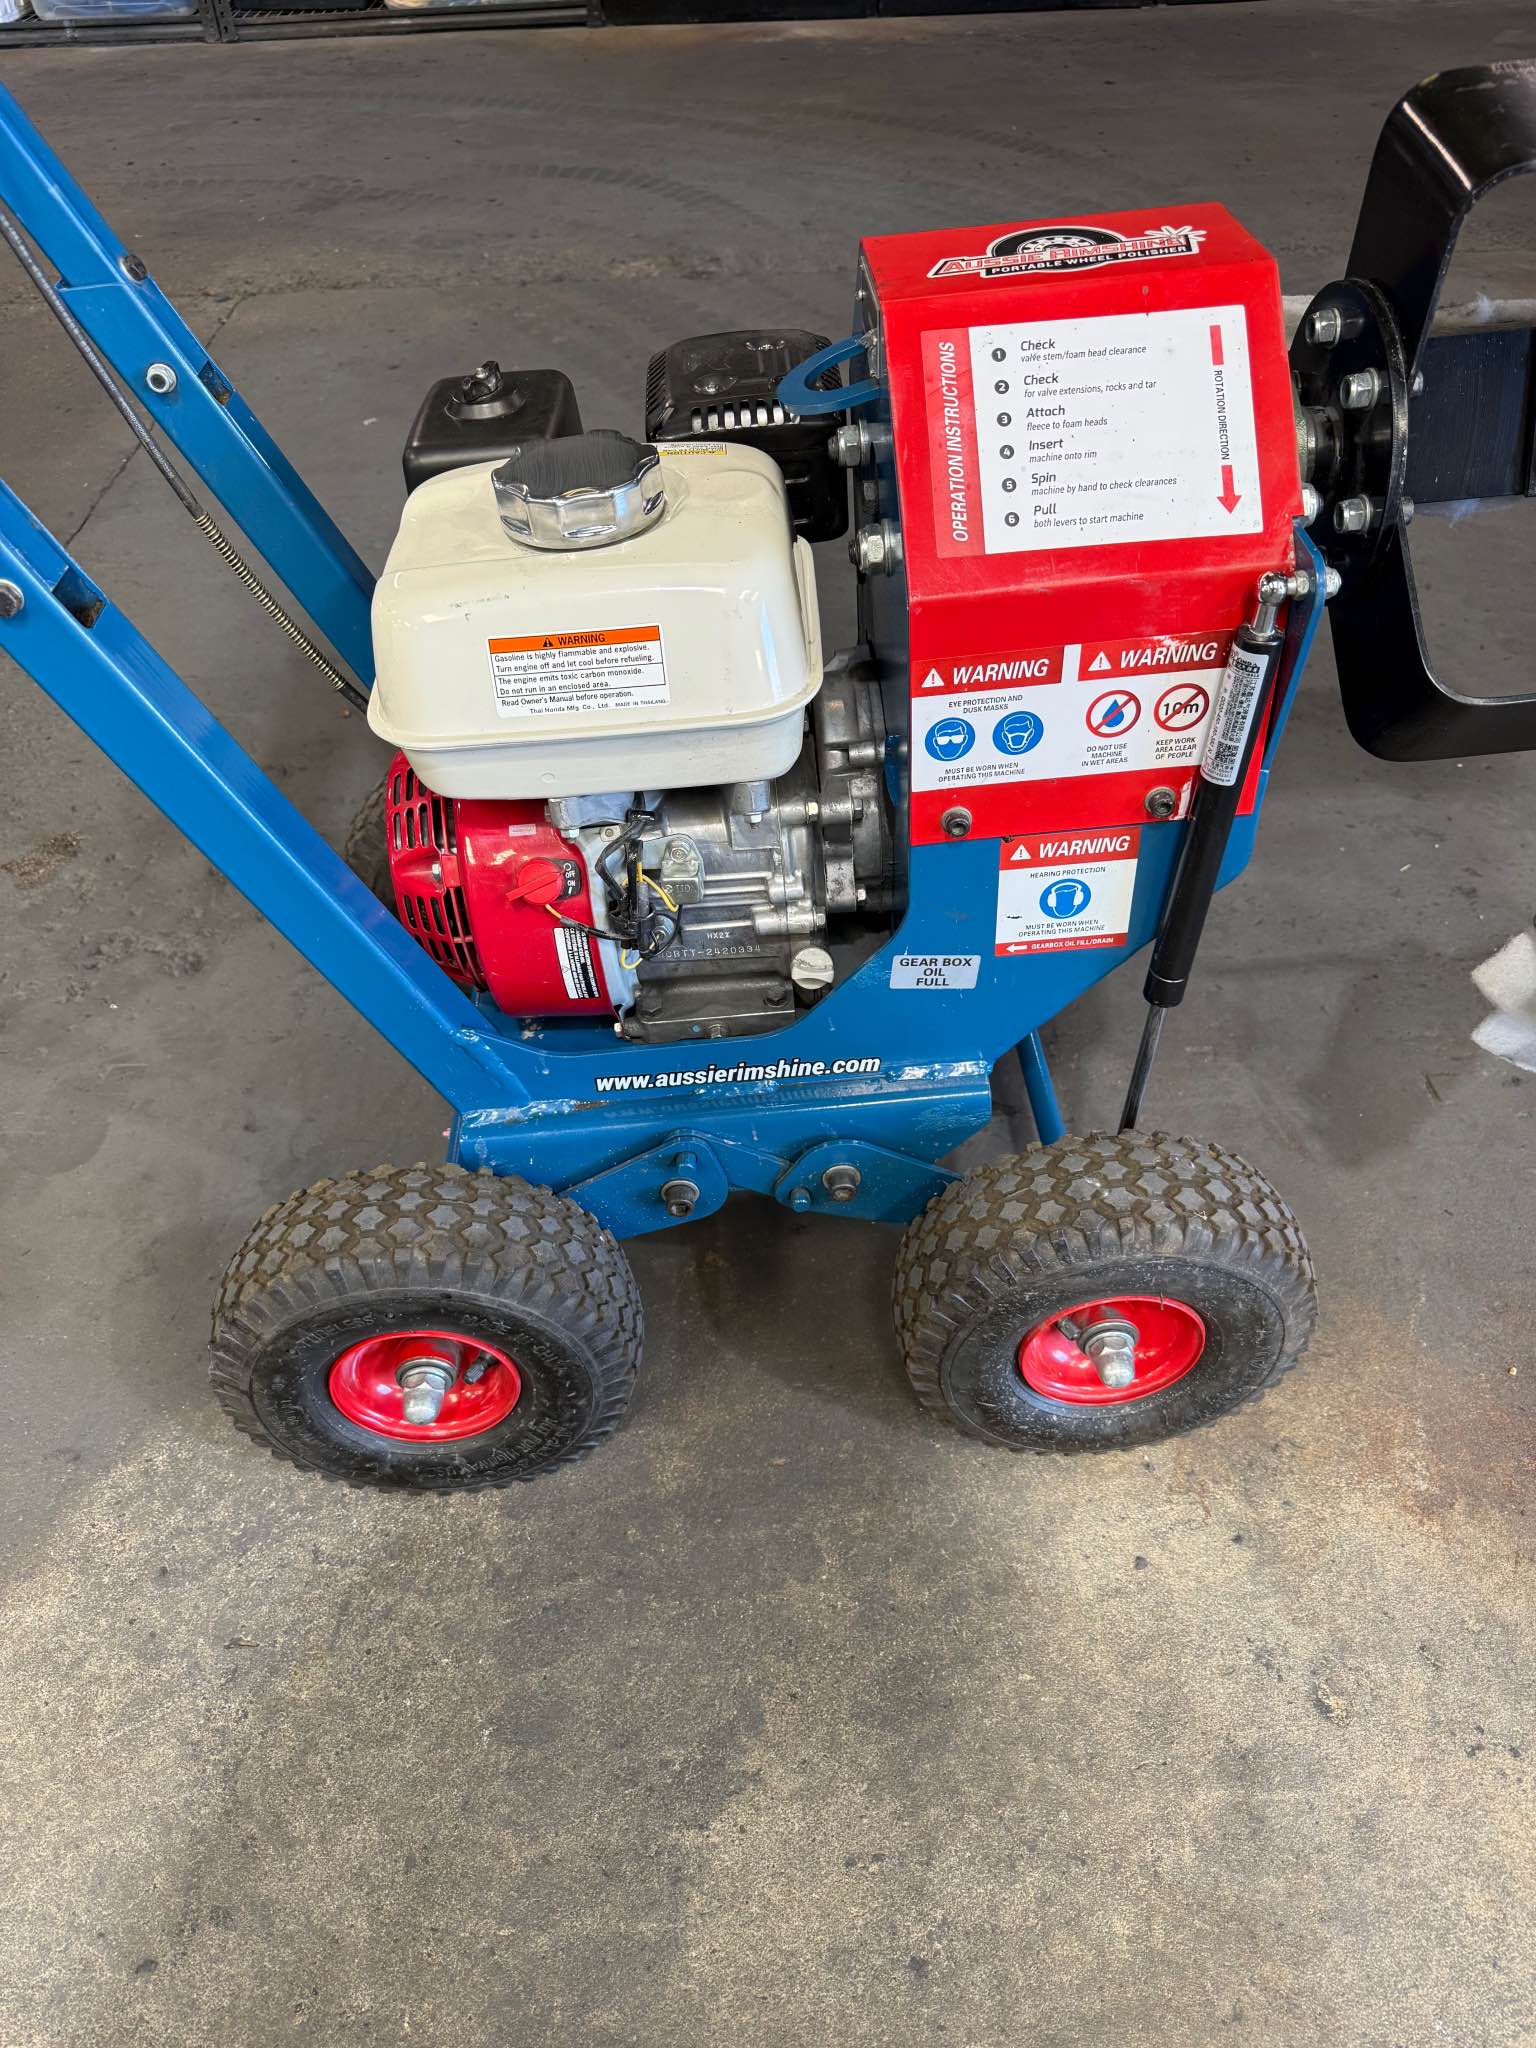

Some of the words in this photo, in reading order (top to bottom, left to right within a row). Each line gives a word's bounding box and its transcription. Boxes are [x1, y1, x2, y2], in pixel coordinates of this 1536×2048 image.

[943, 251, 1042, 273] AUSSIE
[992, 260, 1062, 274] PORTABLE
[1065, 254, 1114, 265] WHEEL
[1119, 246, 1187, 259] POLISHER
[1021, 339, 1055, 351] Check
[1021, 353, 1041, 363] valve
[1043, 350, 1086, 361] stem/foam
[1087, 348, 1107, 357] head
[1108, 345, 1147, 356] clearance
[1024, 373, 1058, 385] Check
[1024, 390, 1036, 398] for
[1037, 388, 1057, 396] valve
[1059, 385, 1103, 395] extensions,
[1105, 381, 1126, 392] rocks
[1127, 381, 1143, 389] and
[1145, 381, 1157, 389] tar
[1214, 370, 1226, 413] ROTATION
[939, 342, 963, 453] INSTRUCTIONS
[1026, 406, 1065, 418] Attach
[1027, 423, 1050, 432] fleece
[1063, 420, 1082, 429] foam
[1084, 417, 1107, 427] heads
[1218, 415, 1229, 460] DIRECTION
[1029, 439, 1063, 451] Insert
[1029, 453, 1062, 463] machine
[1064, 451, 1082, 460] onto
[1084, 450, 1097, 459] rim
[1032, 473, 1056, 485] Spin
[1032, 486, 1064, 496] machine
[1067, 485, 1076, 494] by
[1078, 483, 1098, 493] hand
[1109, 480, 1133, 490] check
[1135, 477, 1177, 487] clearances
[947, 455, 968, 542] OPERATION
[1034, 504, 1056, 515] Pull
[1034, 518, 1052, 528] both
[1054, 517, 1076, 527] levers
[1078, 517, 1087, 525] to
[1089, 515, 1108, 524] start
[1110, 512, 1144, 522] machine
[558, 634, 605, 645] WARNING
[495, 654, 524, 662] Gasoline
[535, 651, 556, 660] highly
[559, 648, 597, 657] flammable
[614, 644, 649, 655] explosive.
[1120, 642, 1218, 668] WARNING
[514, 663, 538, 672] engine
[540, 662, 550, 670] off
[567, 660, 576, 668] let
[595, 657, 619, 665] before
[621, 654, 654, 663] refueling.
[498, 677, 512, 685] The
[514, 676, 537, 685] engine
[539, 674, 559, 682] emits
[580, 670, 605, 679] carbon
[608, 668, 644, 677] monoxide.
[952, 658, 1049, 685] WARNING
[559, 682, 591, 691] enclosed
[521, 696, 547, 705] Owner's
[549, 694, 574, 703] Manual
[576, 693, 598, 701] before
[600, 691, 634, 700] operation.
[963, 696, 1007, 708] PROTECTION
[1008, 694, 1023, 702] AND
[963, 706, 982, 714] DUSK
[983, 704, 1008, 712] MASKS
[1175, 737, 1196, 745] WORK
[1091, 750, 1123, 759] MACHINE
[1167, 751, 1193, 759] PEOPLE
[945, 767, 964, 775] MUST
[975, 764, 998, 772] WORN
[999, 762, 1019, 770] WHEN
[1081, 759, 1089, 767] IN
[1106, 757, 1128, 765] AREAS
[938, 773, 976, 782] OPERATING
[994, 768, 1025, 777] MACHINE
[1040, 836, 1130, 858] WARNING
[1062, 867, 1106, 876] PROTECTION
[1019, 928, 1056, 937] OPERATING
[900, 958, 938, 966] GEAR
[943, 958, 972, 966] BOX
[924, 968, 945, 976] OIL
[916, 978, 949, 986] FULL
[595, 1056, 880, 1092] www.aussierimshine.com
